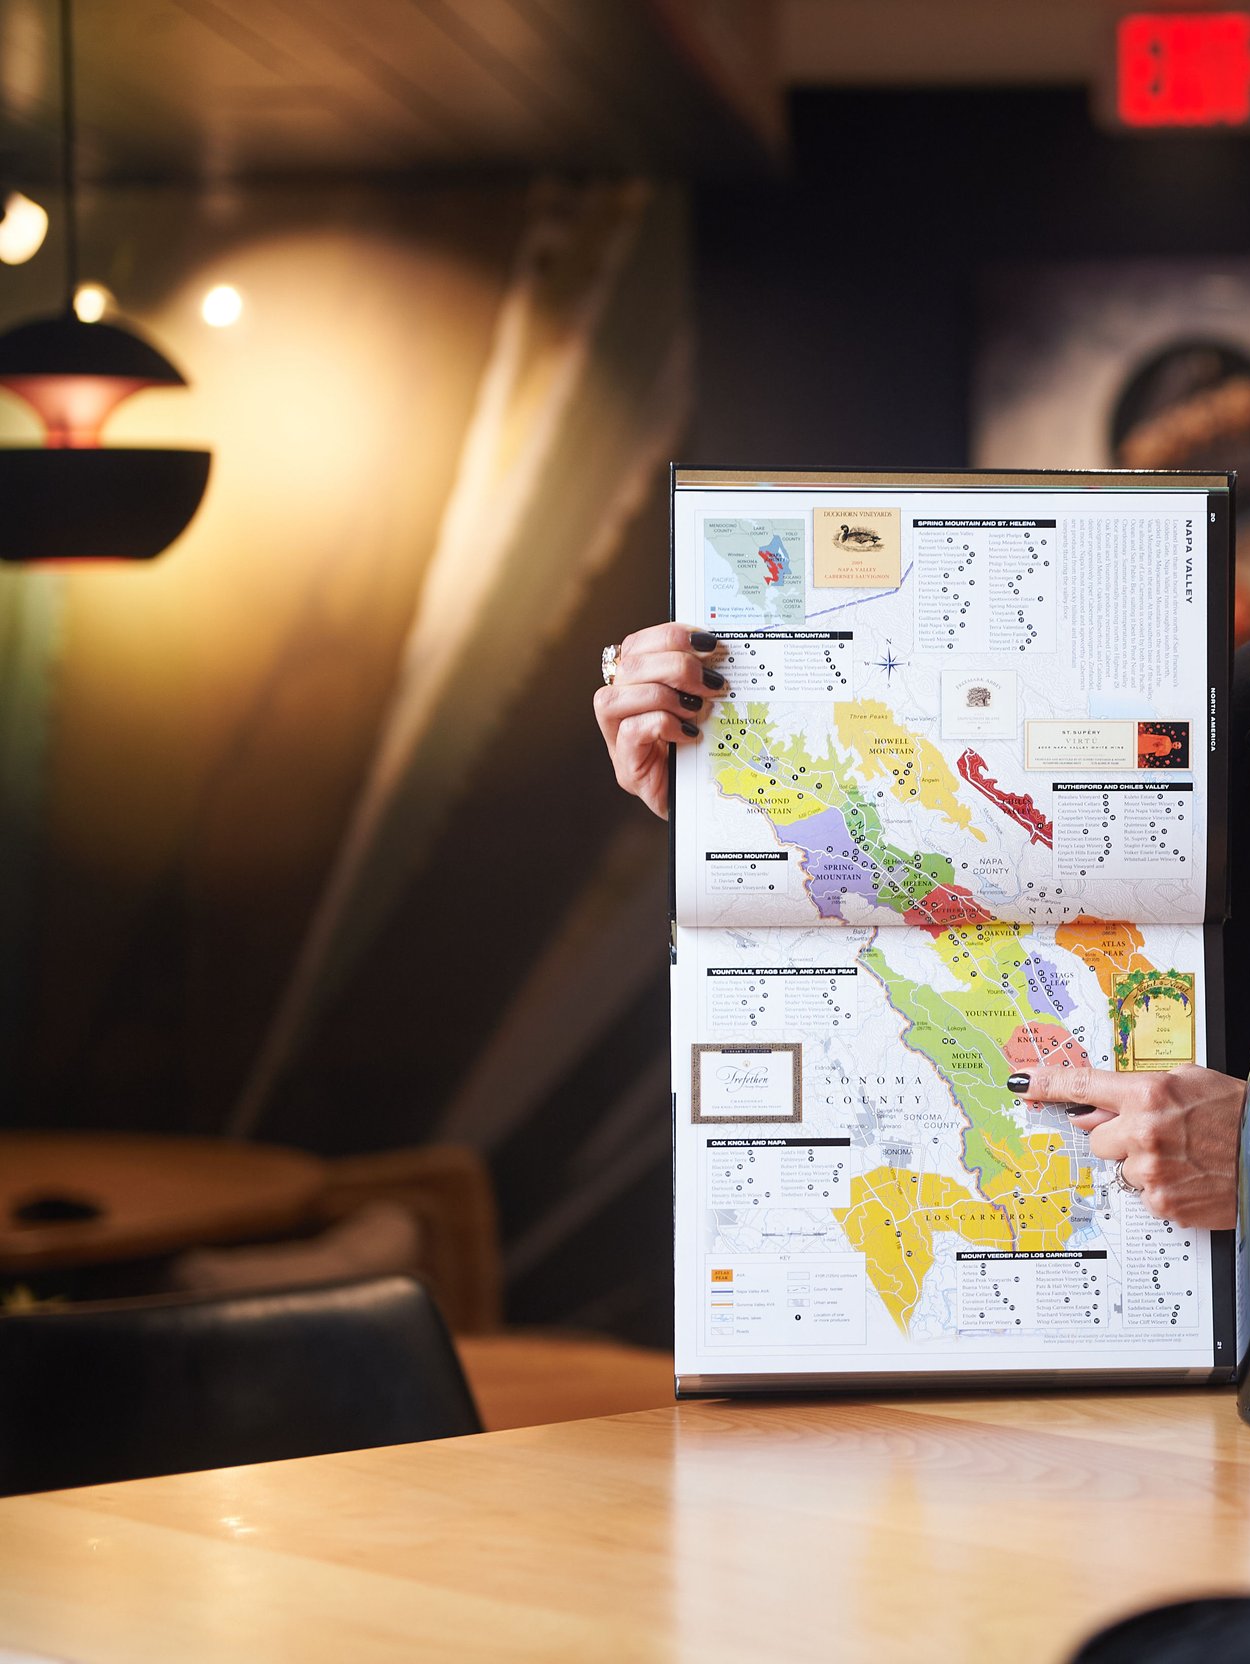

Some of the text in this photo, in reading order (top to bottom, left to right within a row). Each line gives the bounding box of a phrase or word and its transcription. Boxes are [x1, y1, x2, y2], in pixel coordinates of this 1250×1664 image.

[1211, 513, 1215, 522] 20
[824, 864, 854, 872] SPRING
[1217, 1341, 1223, 1349] 21
